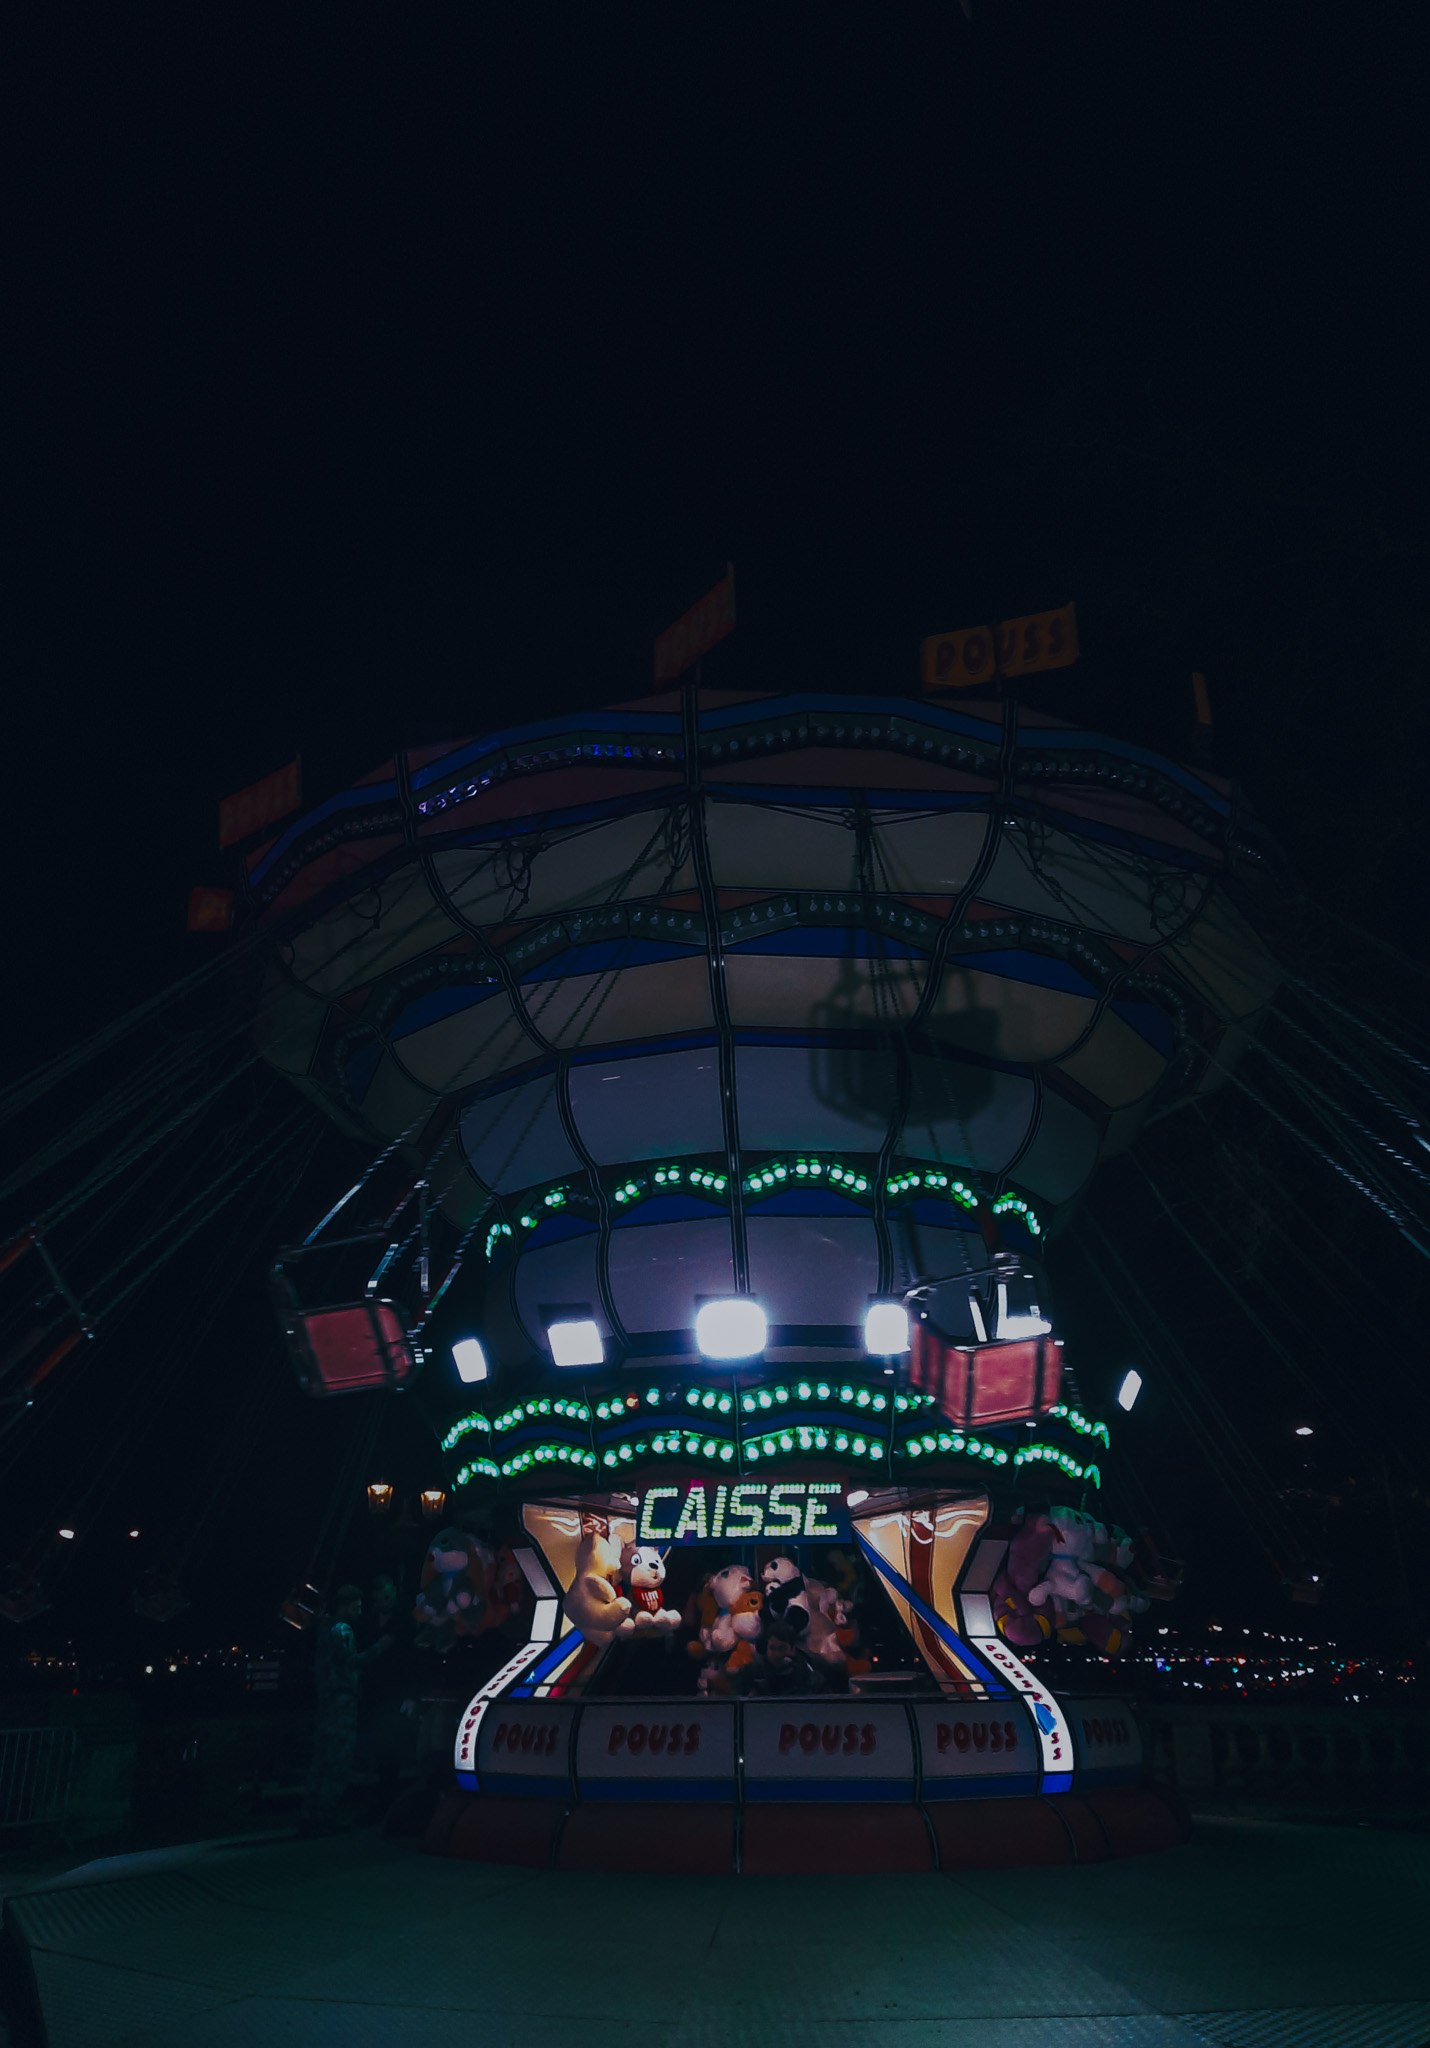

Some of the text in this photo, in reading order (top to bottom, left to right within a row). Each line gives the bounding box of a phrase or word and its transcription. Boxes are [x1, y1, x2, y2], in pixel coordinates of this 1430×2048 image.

[936, 616, 1065, 681] POUSS
[640, 1484, 841, 1539] CAISSE
[488, 1649, 536, 1691] POUSS
[493, 1723, 559, 1755] POUSS
[607, 1723, 701, 1756] POUSS
[779, 1724, 878, 1756] POUSS
[937, 1721, 1018, 1754] POUSS
[1082, 1718, 1131, 1747] POUSS
